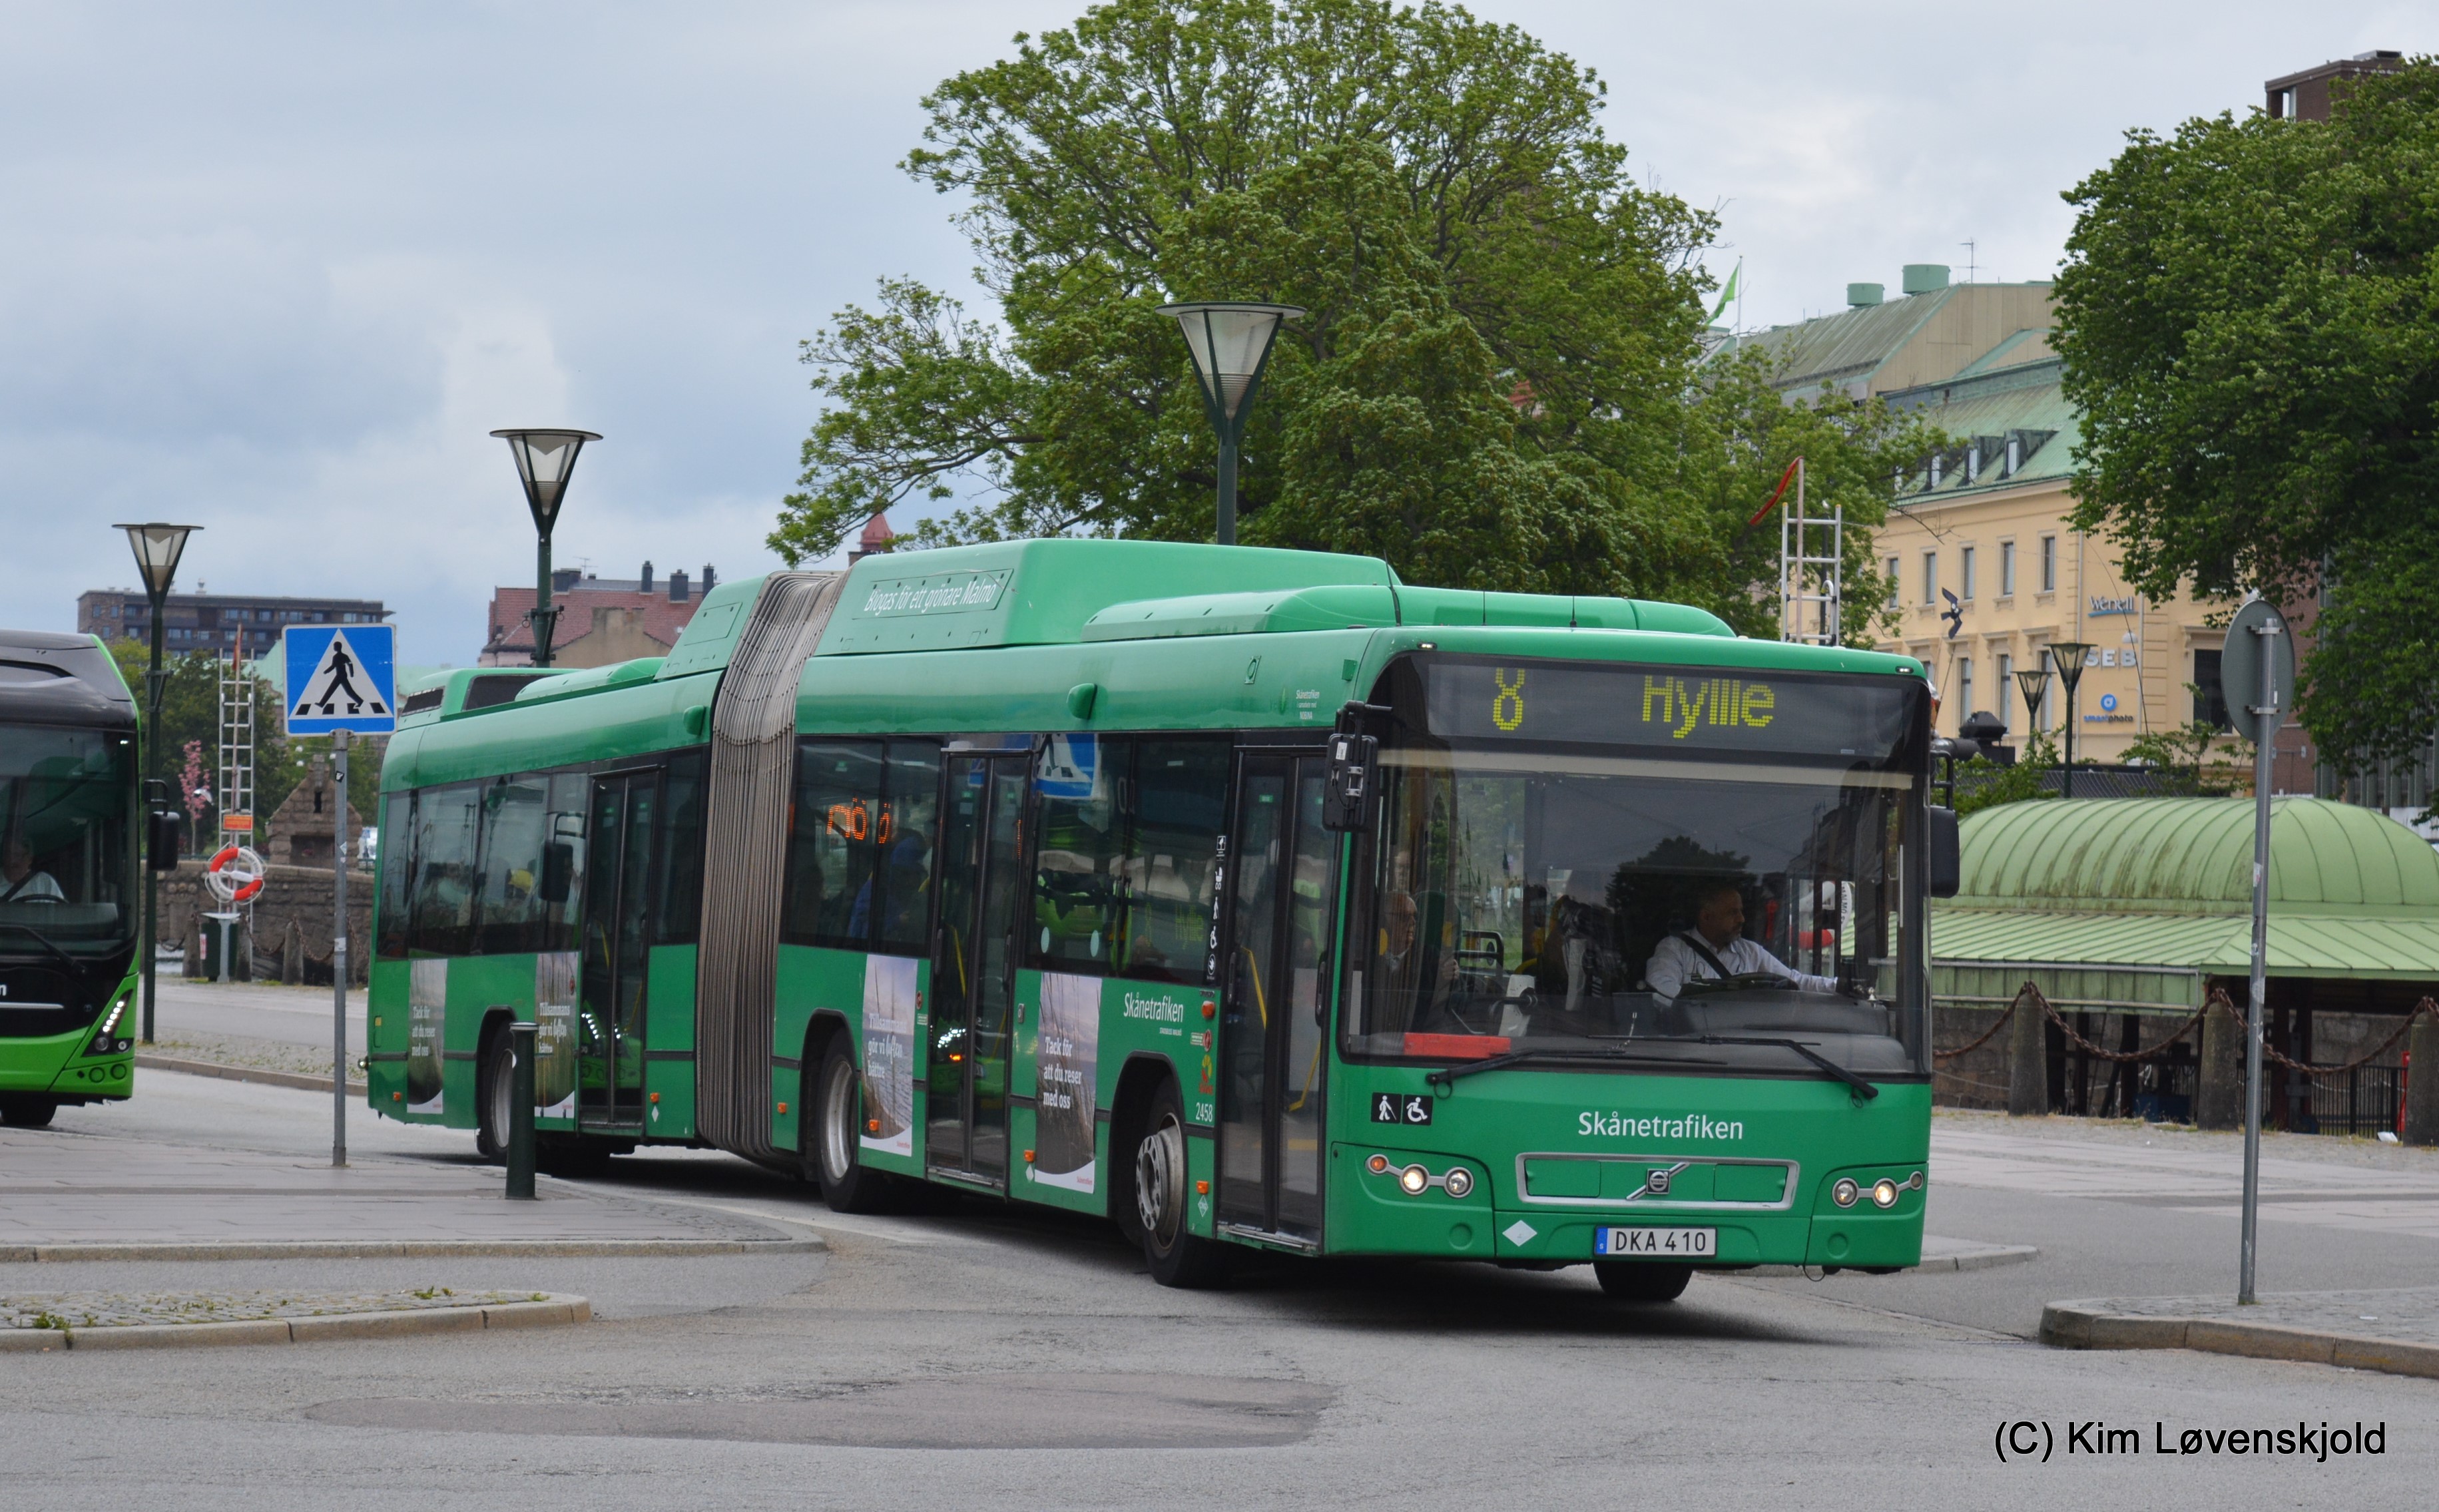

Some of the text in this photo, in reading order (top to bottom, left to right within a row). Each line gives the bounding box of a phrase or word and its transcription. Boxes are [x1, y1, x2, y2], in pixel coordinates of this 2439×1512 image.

[864, 579, 999, 616] Biogas för ett grönare Malmö
[2089, 596, 2134, 611] Wenell
[1493, 668, 1525, 730] 8
[2083, 714, 2134, 722] smartphoto
[413, 1006, 423, 1018] Tack
[539, 1002, 570, 1016] Tillsammans
[1124, 992, 1183, 1023] Skånetrafiken
[869, 1013, 907, 1032] Tillsammans
[868, 1037, 878, 1056] gör
[879, 1039, 886, 1054] vi
[1045, 1037, 1072, 1057] Tack för
[868, 1061, 885, 1079] bättre
[1043, 1063, 1082, 1085] att du reser
[1043, 1089, 1071, 1109] med oss
[1196, 1103, 1213, 1122] 2458
[1578, 1111, 1743, 1139] Skånetrafiken
[1615, 1231, 1657, 1251] DKA
[1665, 1232, 1706, 1252] 410
